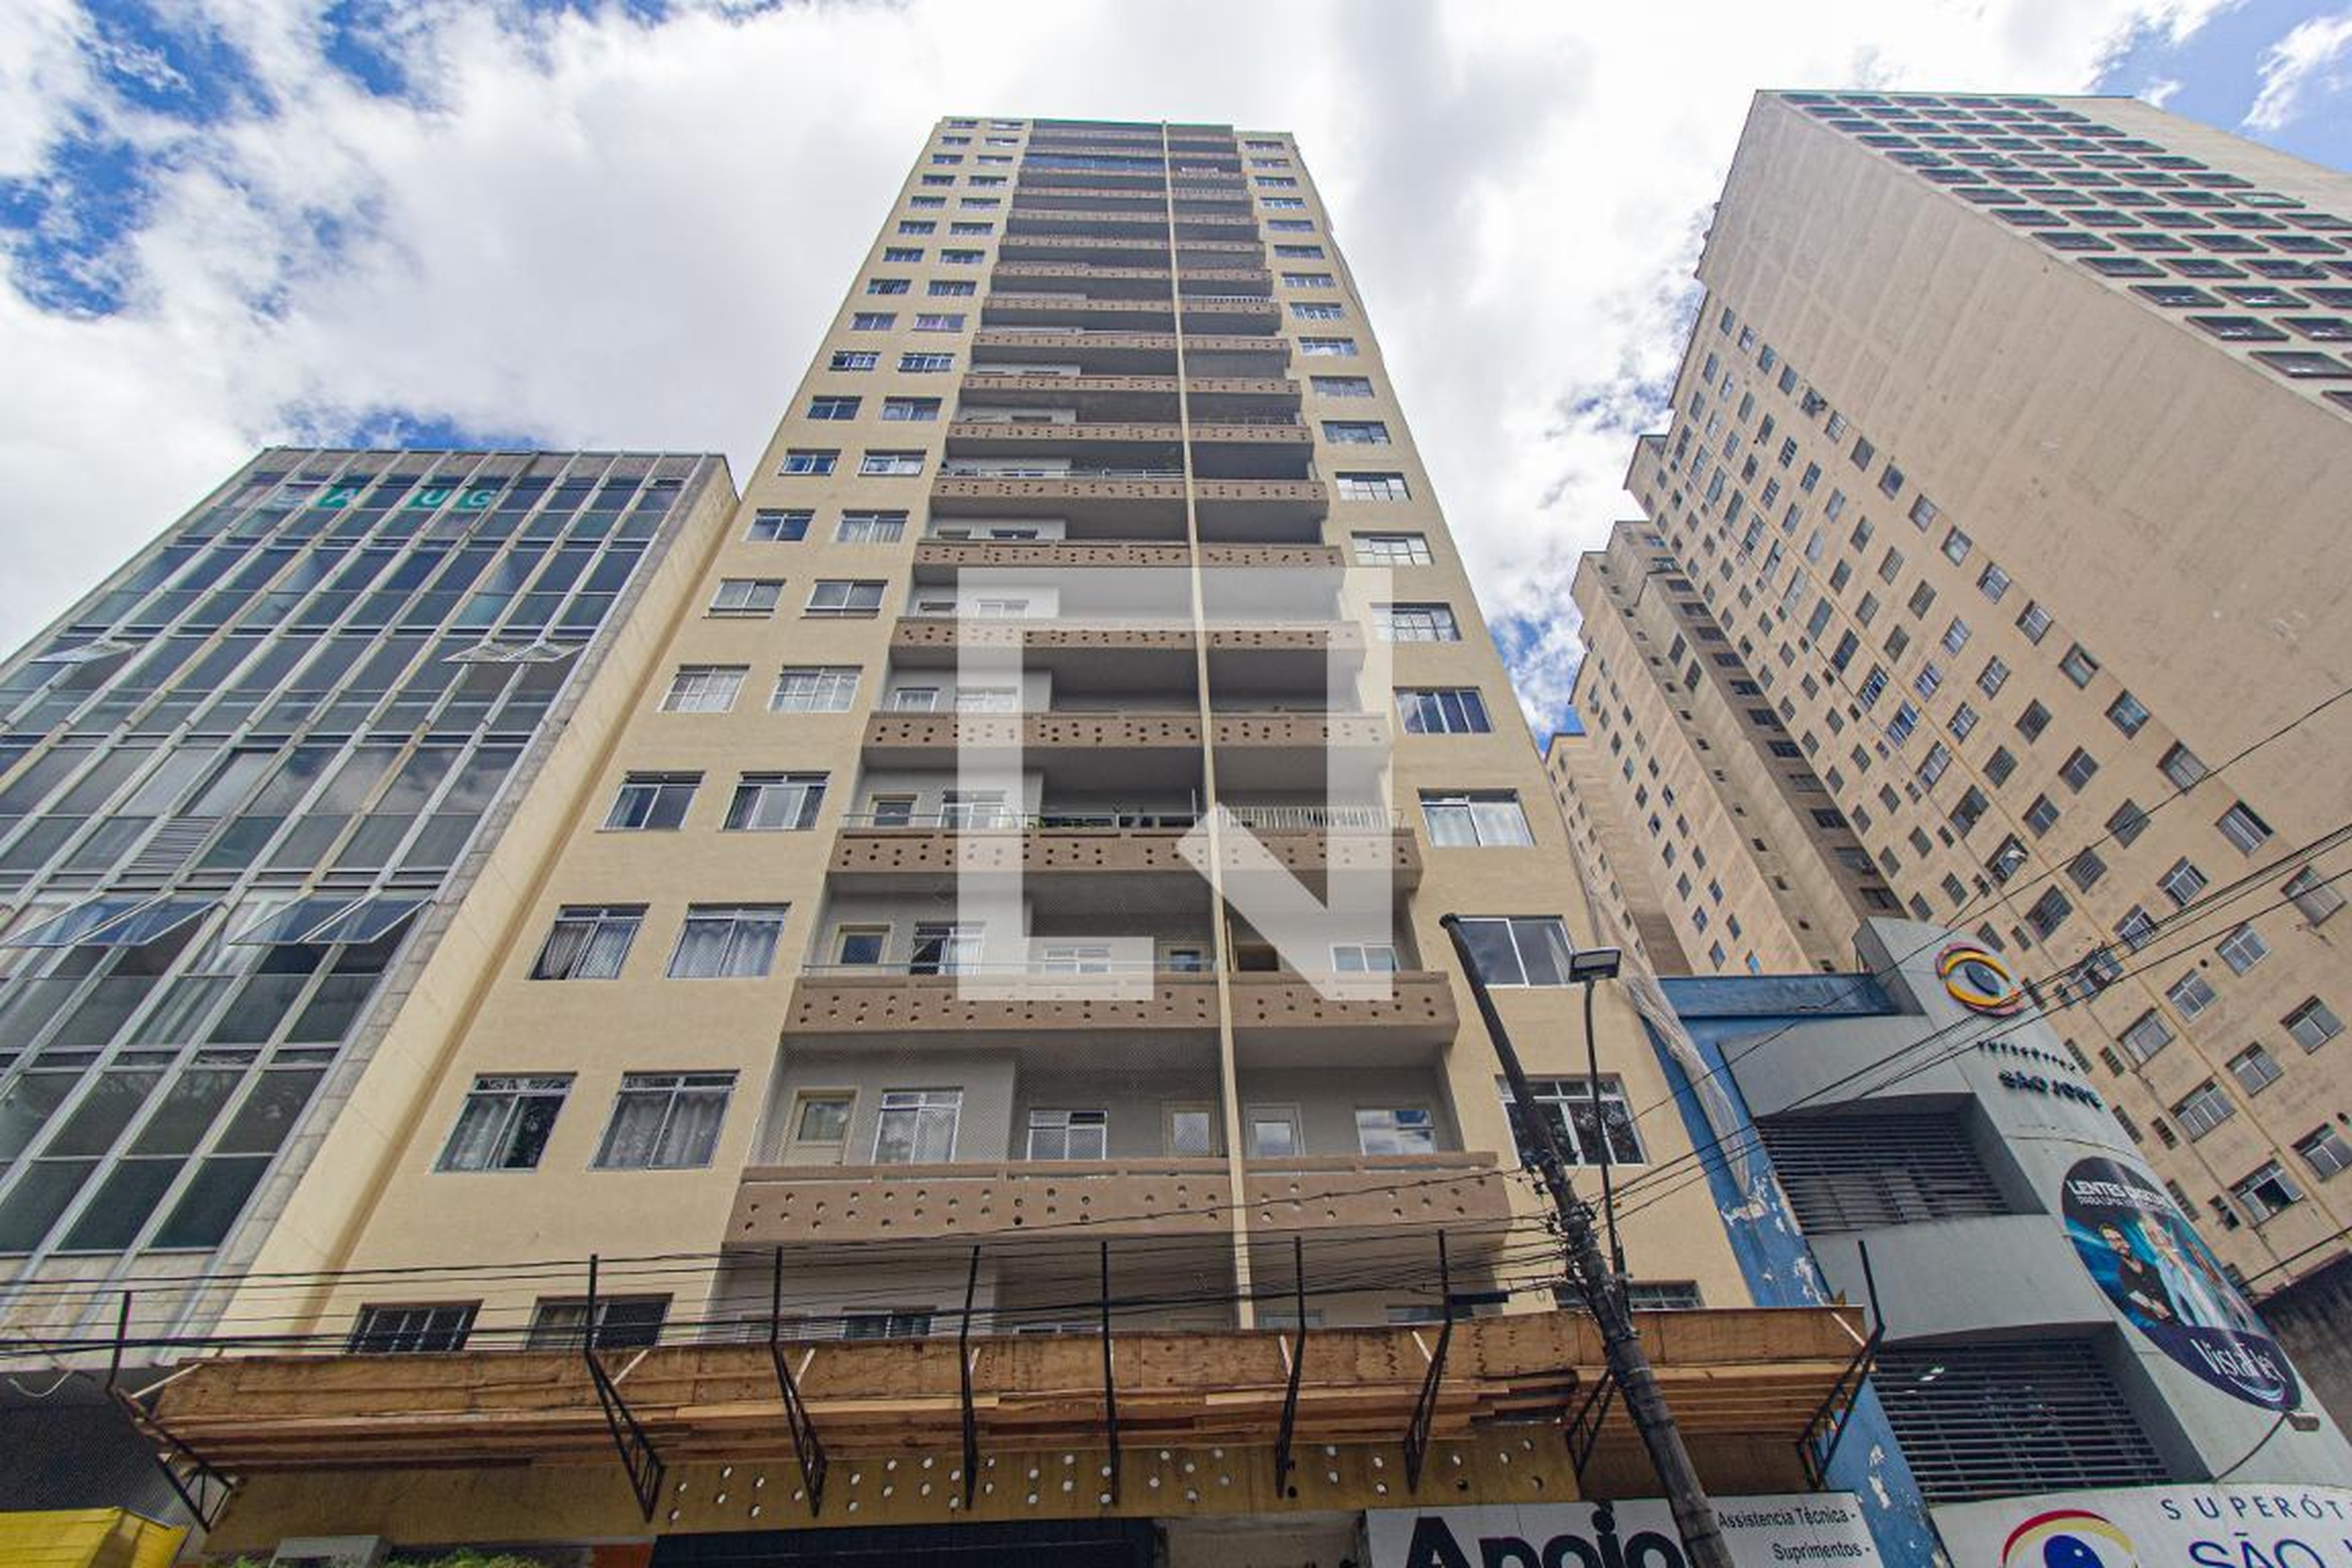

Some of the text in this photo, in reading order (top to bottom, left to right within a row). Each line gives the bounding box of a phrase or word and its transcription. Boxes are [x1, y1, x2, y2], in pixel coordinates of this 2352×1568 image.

[2066, 1179, 2126, 1197] LENTES
[1795, 1507, 1848, 1525] Técnica
[1772, 1542, 1862, 1564] Suprimentos
